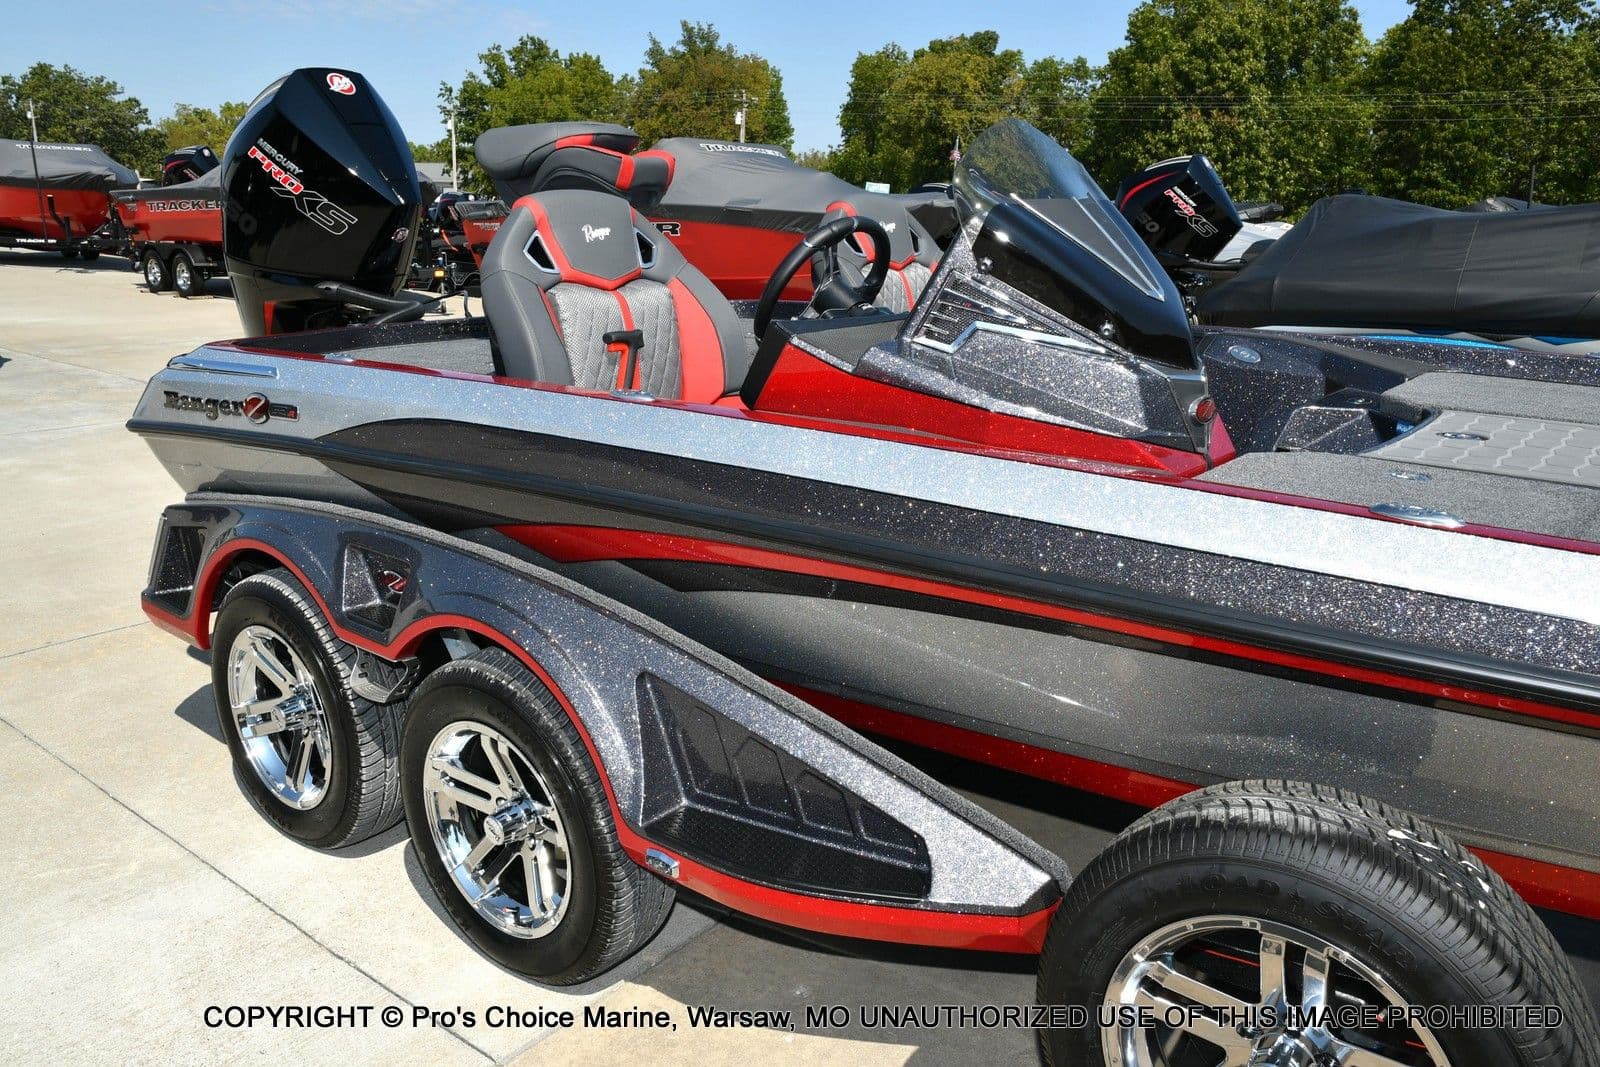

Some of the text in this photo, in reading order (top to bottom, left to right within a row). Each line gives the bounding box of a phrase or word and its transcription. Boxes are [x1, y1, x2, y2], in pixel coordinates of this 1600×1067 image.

[247, 145, 305, 195] PRO
[256, 137, 304, 175] MERCURY
[269, 186, 358, 235] XS
[1163, 188, 1197, 217] PRO
[580, 223, 612, 243] Ranger
[1174, 209, 1219, 238] XS
[163, 390, 244, 421] Ranger
